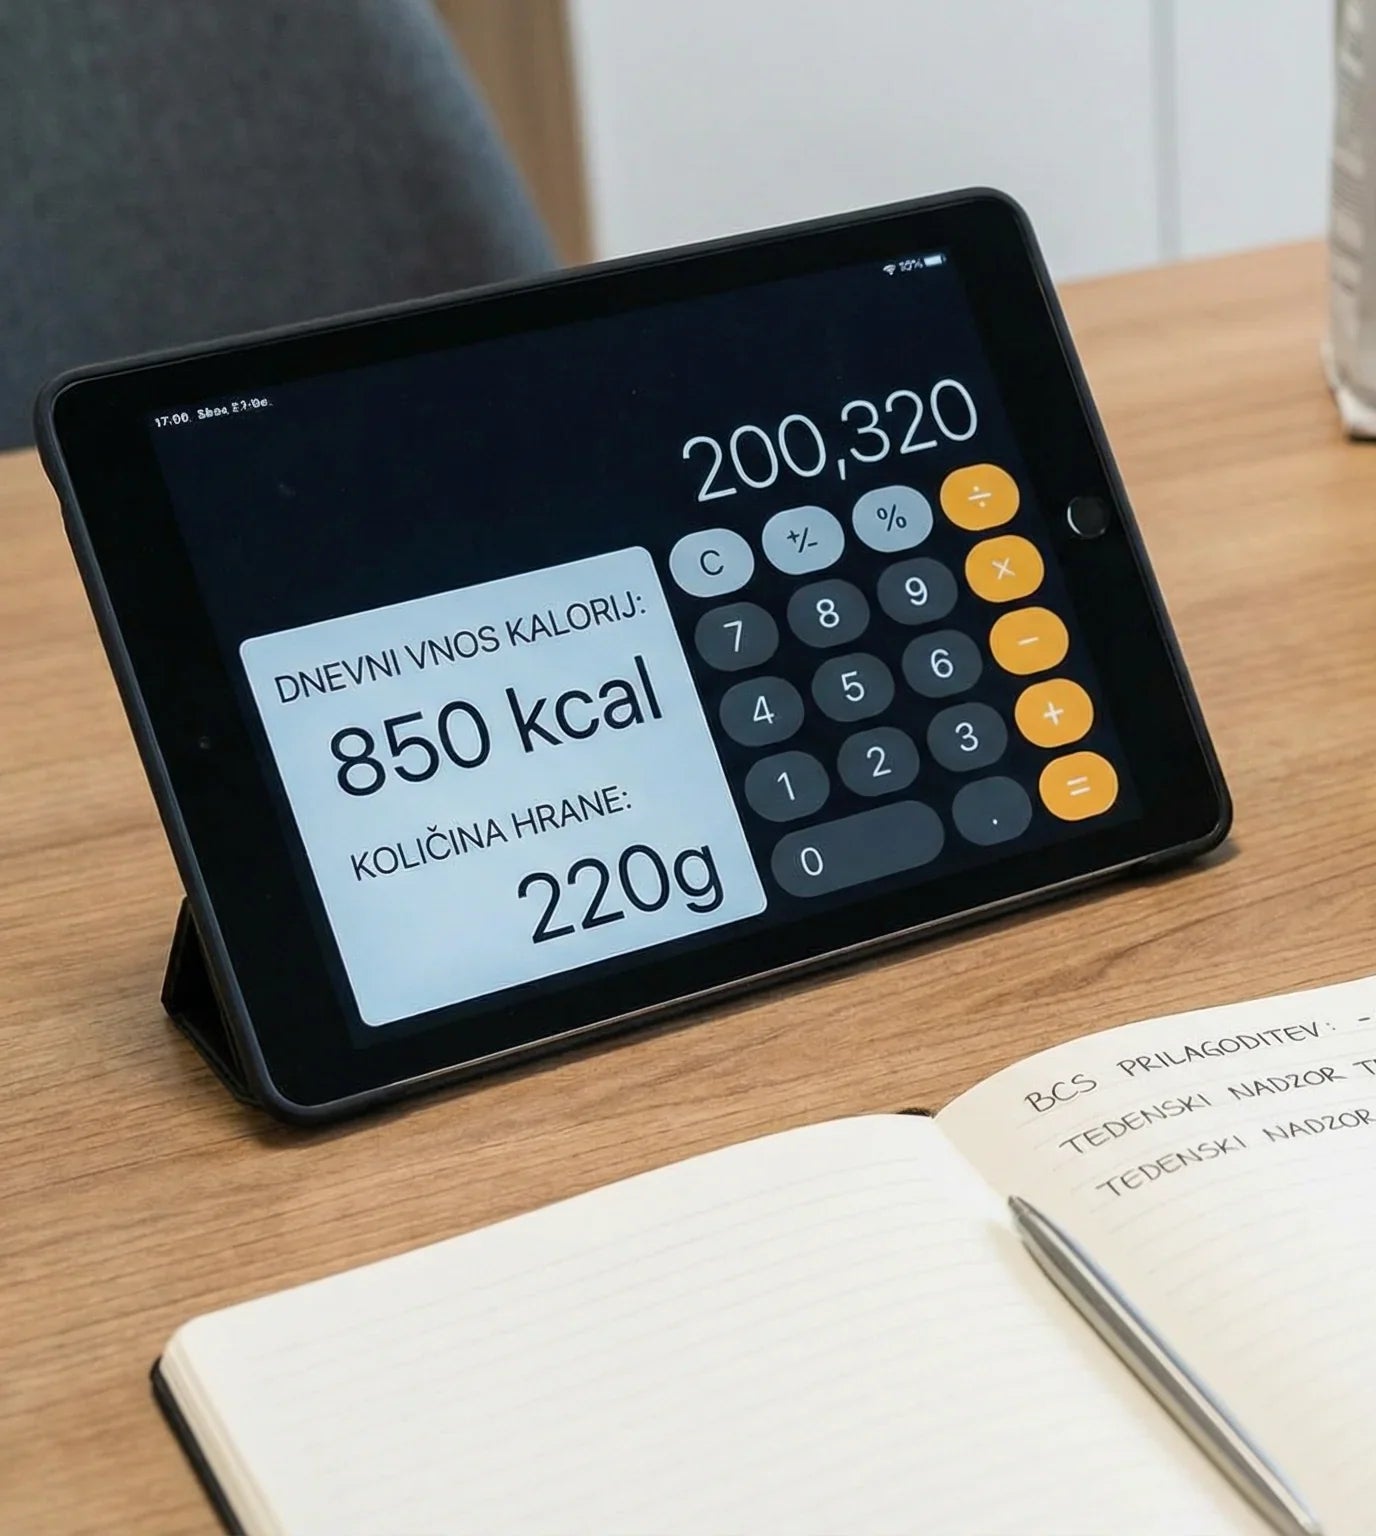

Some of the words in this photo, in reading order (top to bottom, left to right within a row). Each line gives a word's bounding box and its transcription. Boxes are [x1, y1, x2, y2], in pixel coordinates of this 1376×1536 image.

[682, 378, 977, 502] 200,320
[699, 550, 724, 576] C
[876, 504, 907, 530] %
[275, 648, 401, 703] DNEVNI
[405, 626, 500, 670] VNOS
[505, 591, 646, 647] KALORIJ:
[723, 620, 743, 652] 7
[815, 599, 840, 628] 8
[904, 577, 928, 606] 9
[330, 700, 491, 797] 850
[505, 655, 663, 753] kcal
[752, 695, 775, 725] 4
[841, 671, 865, 702] 5
[930, 648, 954, 679] 6
[777, 772, 796, 801] 1
[866, 747, 891, 777] 2
[955, 722, 978, 752] 3
[349, 817, 508, 881] KOLIČINA
[511, 786, 632, 839] HRANE:
[800, 847, 824, 877] 0
[517, 844, 725, 944] 220g
[1024, 1074, 1098, 1115] BCS
[1118, 1021, 1336, 1079] PRILAGODITEV:
[1059, 1093, 1212, 1155] TEDENSKI
[1228, 1067, 1347, 1101] NADZOR
[1096, 1134, 1248, 1200] TEDENSKI
